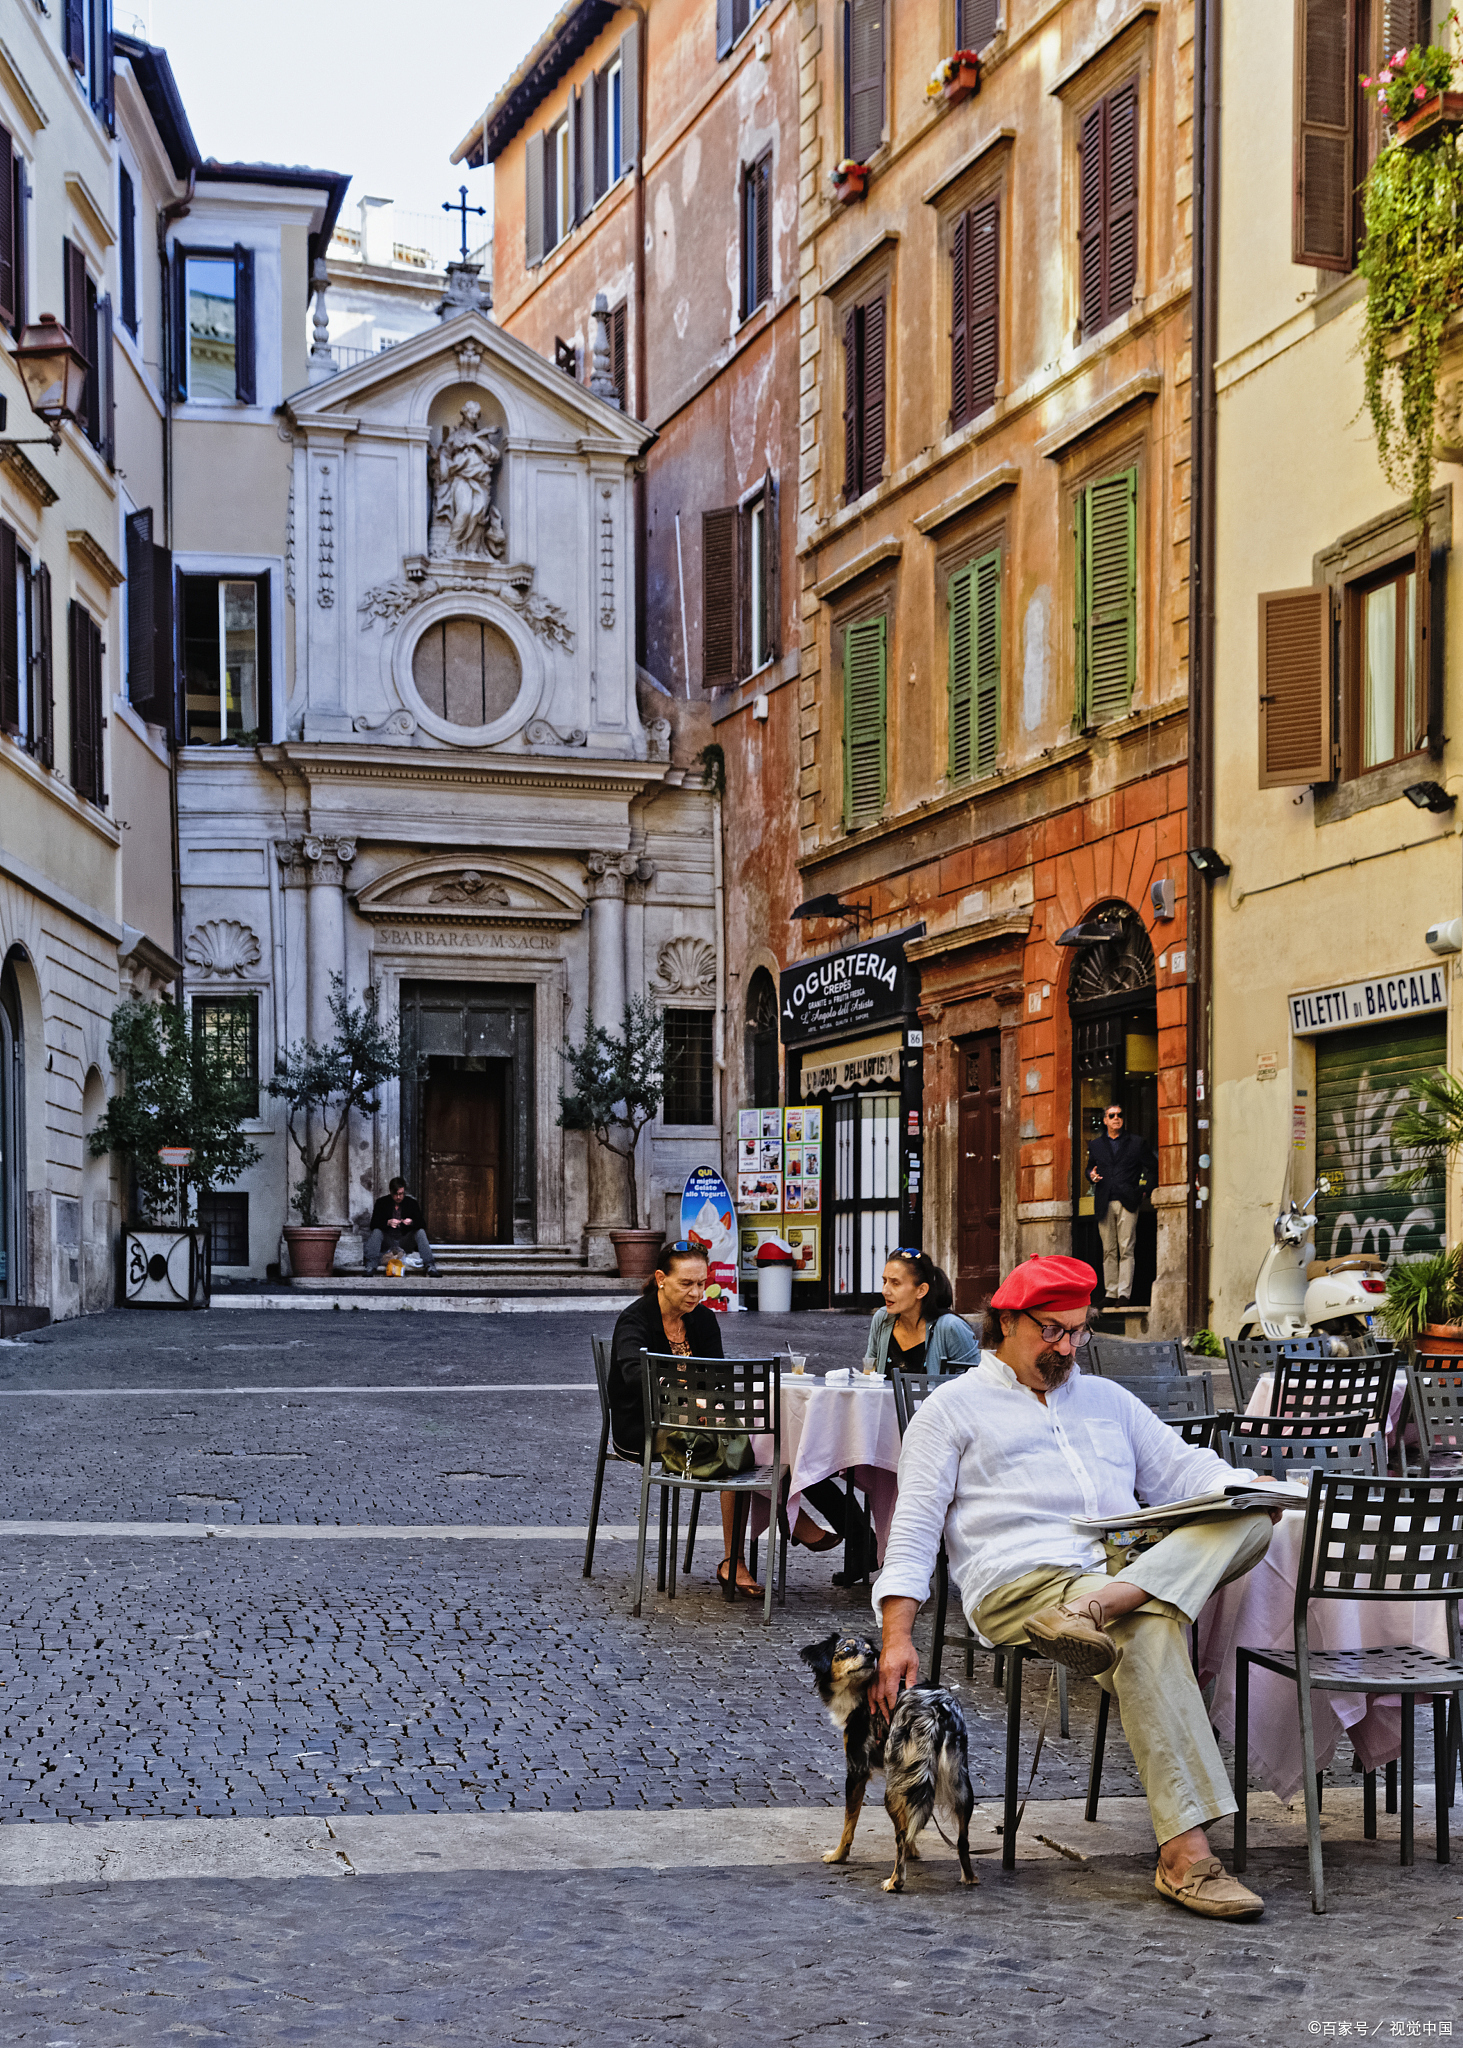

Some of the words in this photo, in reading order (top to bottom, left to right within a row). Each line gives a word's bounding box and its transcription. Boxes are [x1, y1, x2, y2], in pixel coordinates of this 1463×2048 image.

[782, 952, 898, 1020] YOGURTERIA
[1293, 991, 1349, 1029] FILETTI
[1353, 1001, 1363, 1018] DI
[910, 1033, 921, 1044] 86
[697, 1169, 713, 1178] QUI
[696, 1178, 721, 1186] miglior
[700, 1191, 727, 1199] Yogurt!
